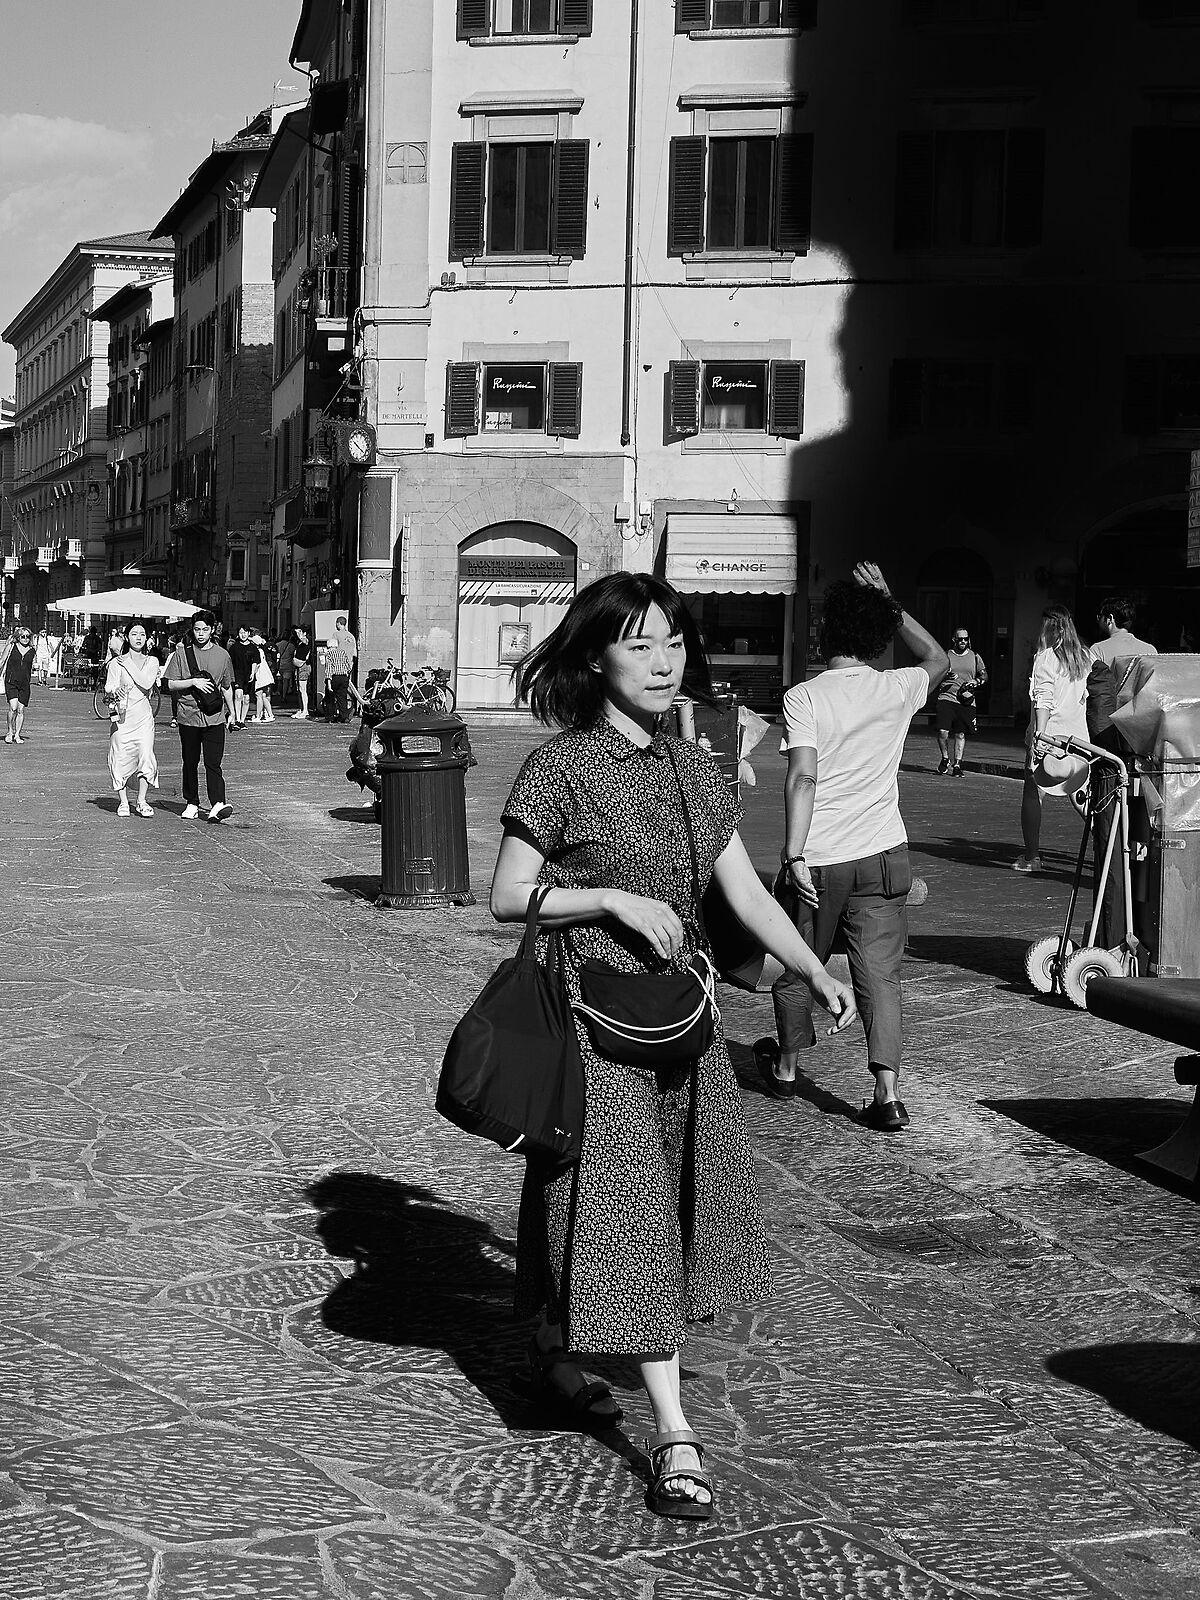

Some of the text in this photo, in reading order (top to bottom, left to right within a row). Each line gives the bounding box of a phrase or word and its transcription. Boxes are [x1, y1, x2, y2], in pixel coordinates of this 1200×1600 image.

[468, 560, 566, 570] MONTE DEI PASCHI
[711, 563, 767, 572] CHANGE
[468, 568, 480, 577] DI
[482, 568, 513, 577] SIENA
